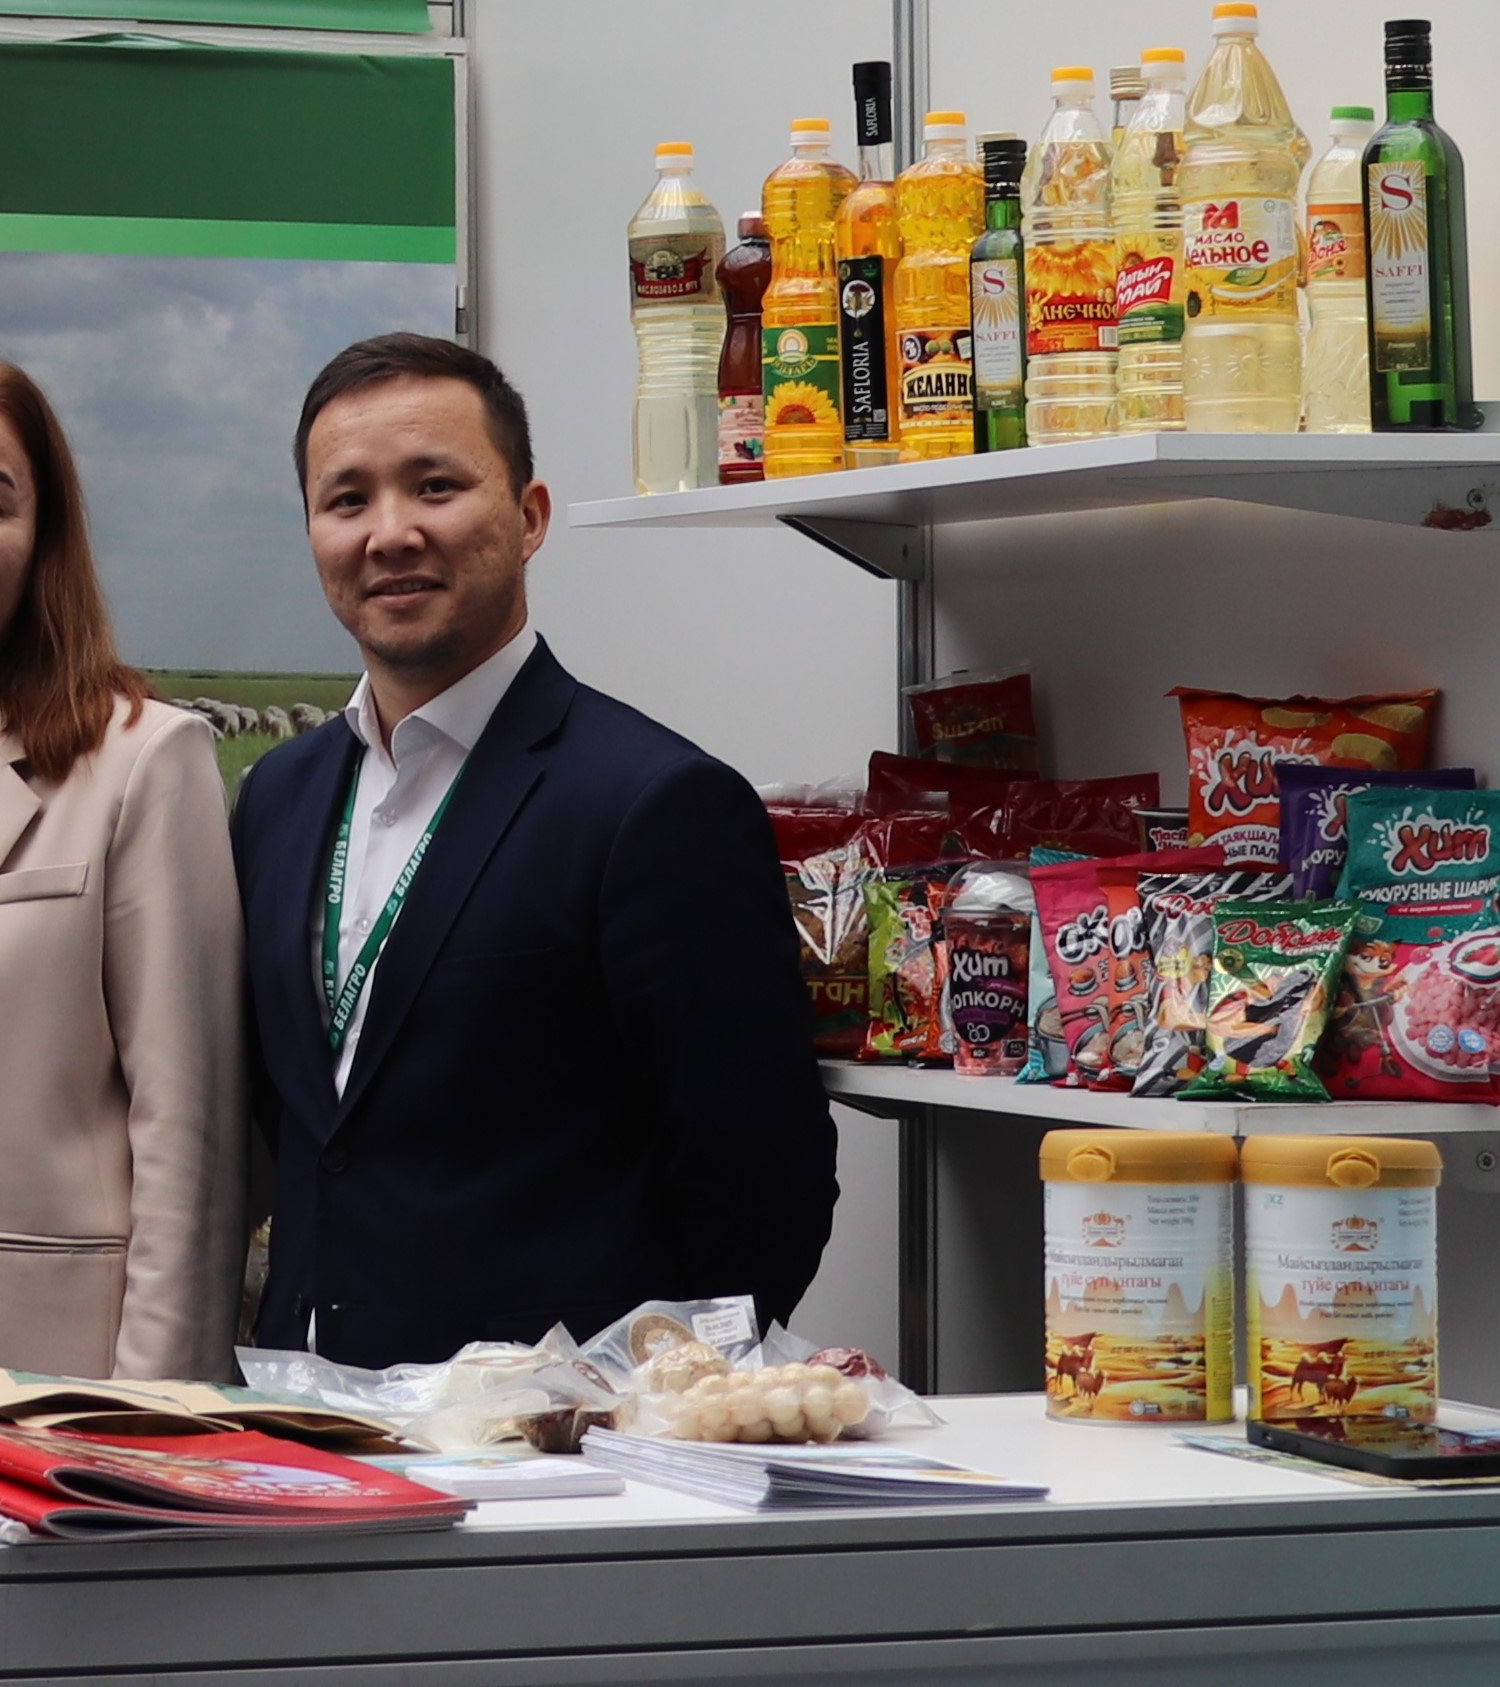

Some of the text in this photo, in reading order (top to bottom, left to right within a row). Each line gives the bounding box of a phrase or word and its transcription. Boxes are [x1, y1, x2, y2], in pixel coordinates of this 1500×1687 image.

[866, 97, 877, 136] SAFLORIA
[1380, 175, 1413, 211] S
[983, 269, 1005, 295] S
[1375, 265, 1423, 278] SAFFI
[976, 331, 1017, 342] SAFFI
[853, 340, 871, 413] SAFLORIA
[327, 840, 348, 904] БЕЛАГРО
[1358, 883, 1450, 902] КУКУРУЗНЫЕ
[334, 963, 366, 1029] БЕЛАГРО
